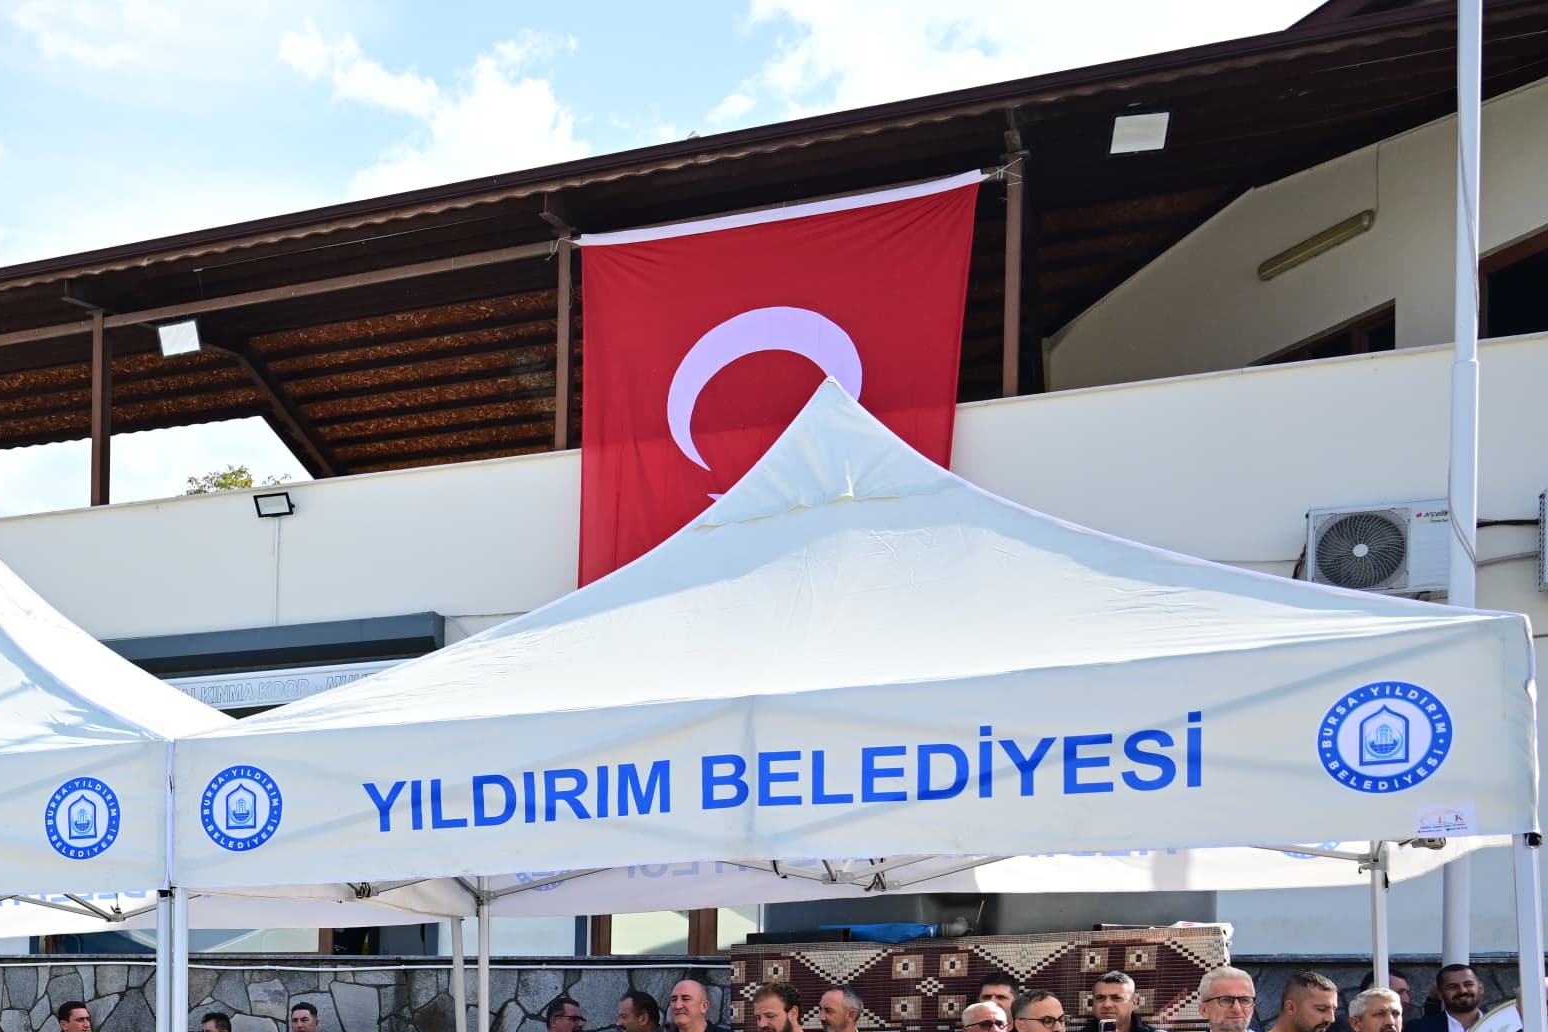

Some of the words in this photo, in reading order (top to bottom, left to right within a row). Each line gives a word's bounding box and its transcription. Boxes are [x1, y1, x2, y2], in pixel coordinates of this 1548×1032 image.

[178, 682, 252, 704] KINMA
[1322, 697, 1358, 748] BURSA
[1370, 685, 1447, 734] YILDIRIM
[203, 776, 225, 815] BURSA
[231, 768, 279, 807] YILDIRIM
[362, 759, 670, 832] YILDIRIM
[701, 711, 1202, 810] BELEDİYESİ
[47, 788, 68, 826] BURSA
[74, 780, 117, 817] YILDIRIM
